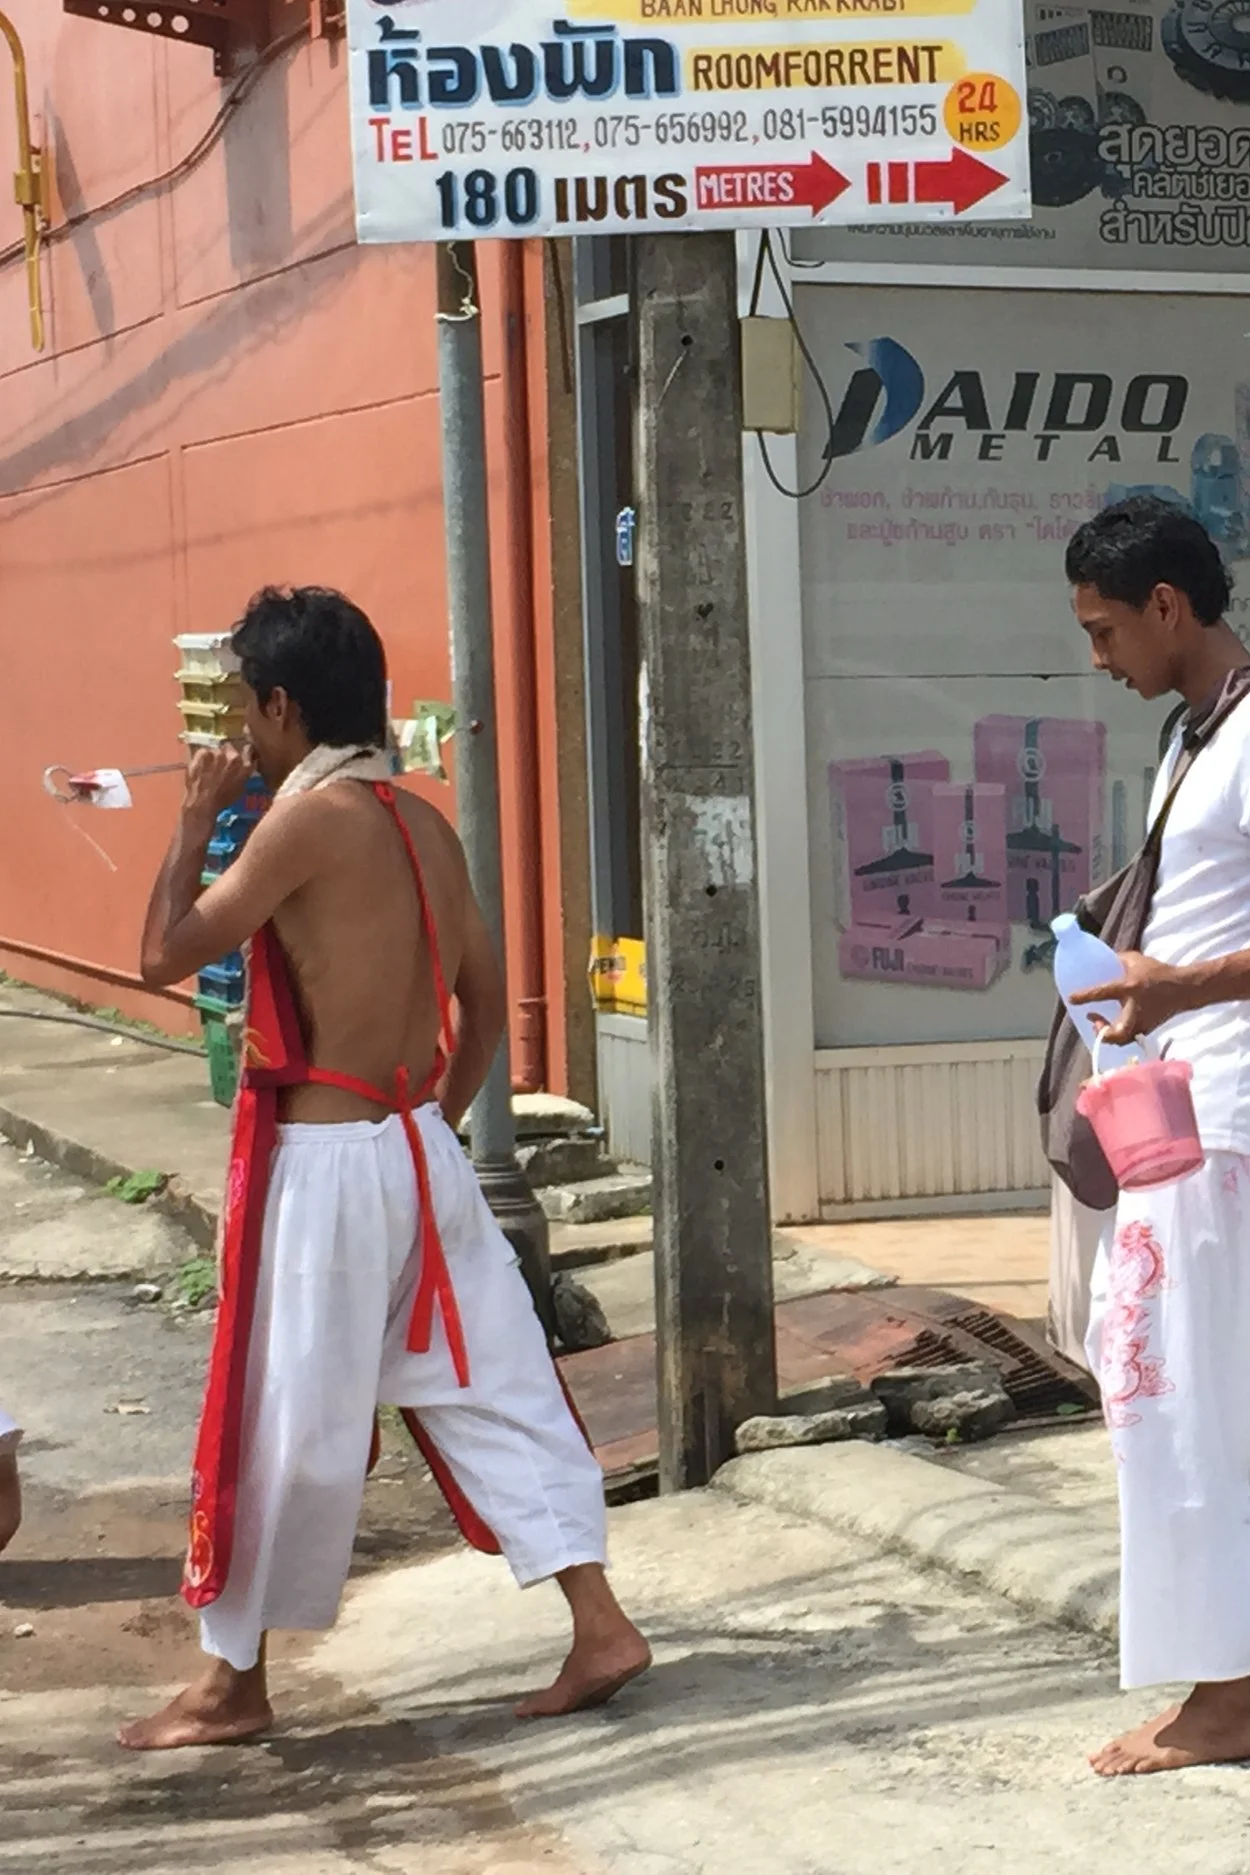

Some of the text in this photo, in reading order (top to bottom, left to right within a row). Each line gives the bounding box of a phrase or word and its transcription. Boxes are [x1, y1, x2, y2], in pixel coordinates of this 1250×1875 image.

[368, 15, 678, 108] ห้องพัก
[957, 80, 997, 115] 24
[368, 116, 438, 162] TEL
[958, 119, 1001, 143] HRS
[436, 167, 795, 228] 180 เมตร METRES
[909, 432, 1181, 463] METAL
